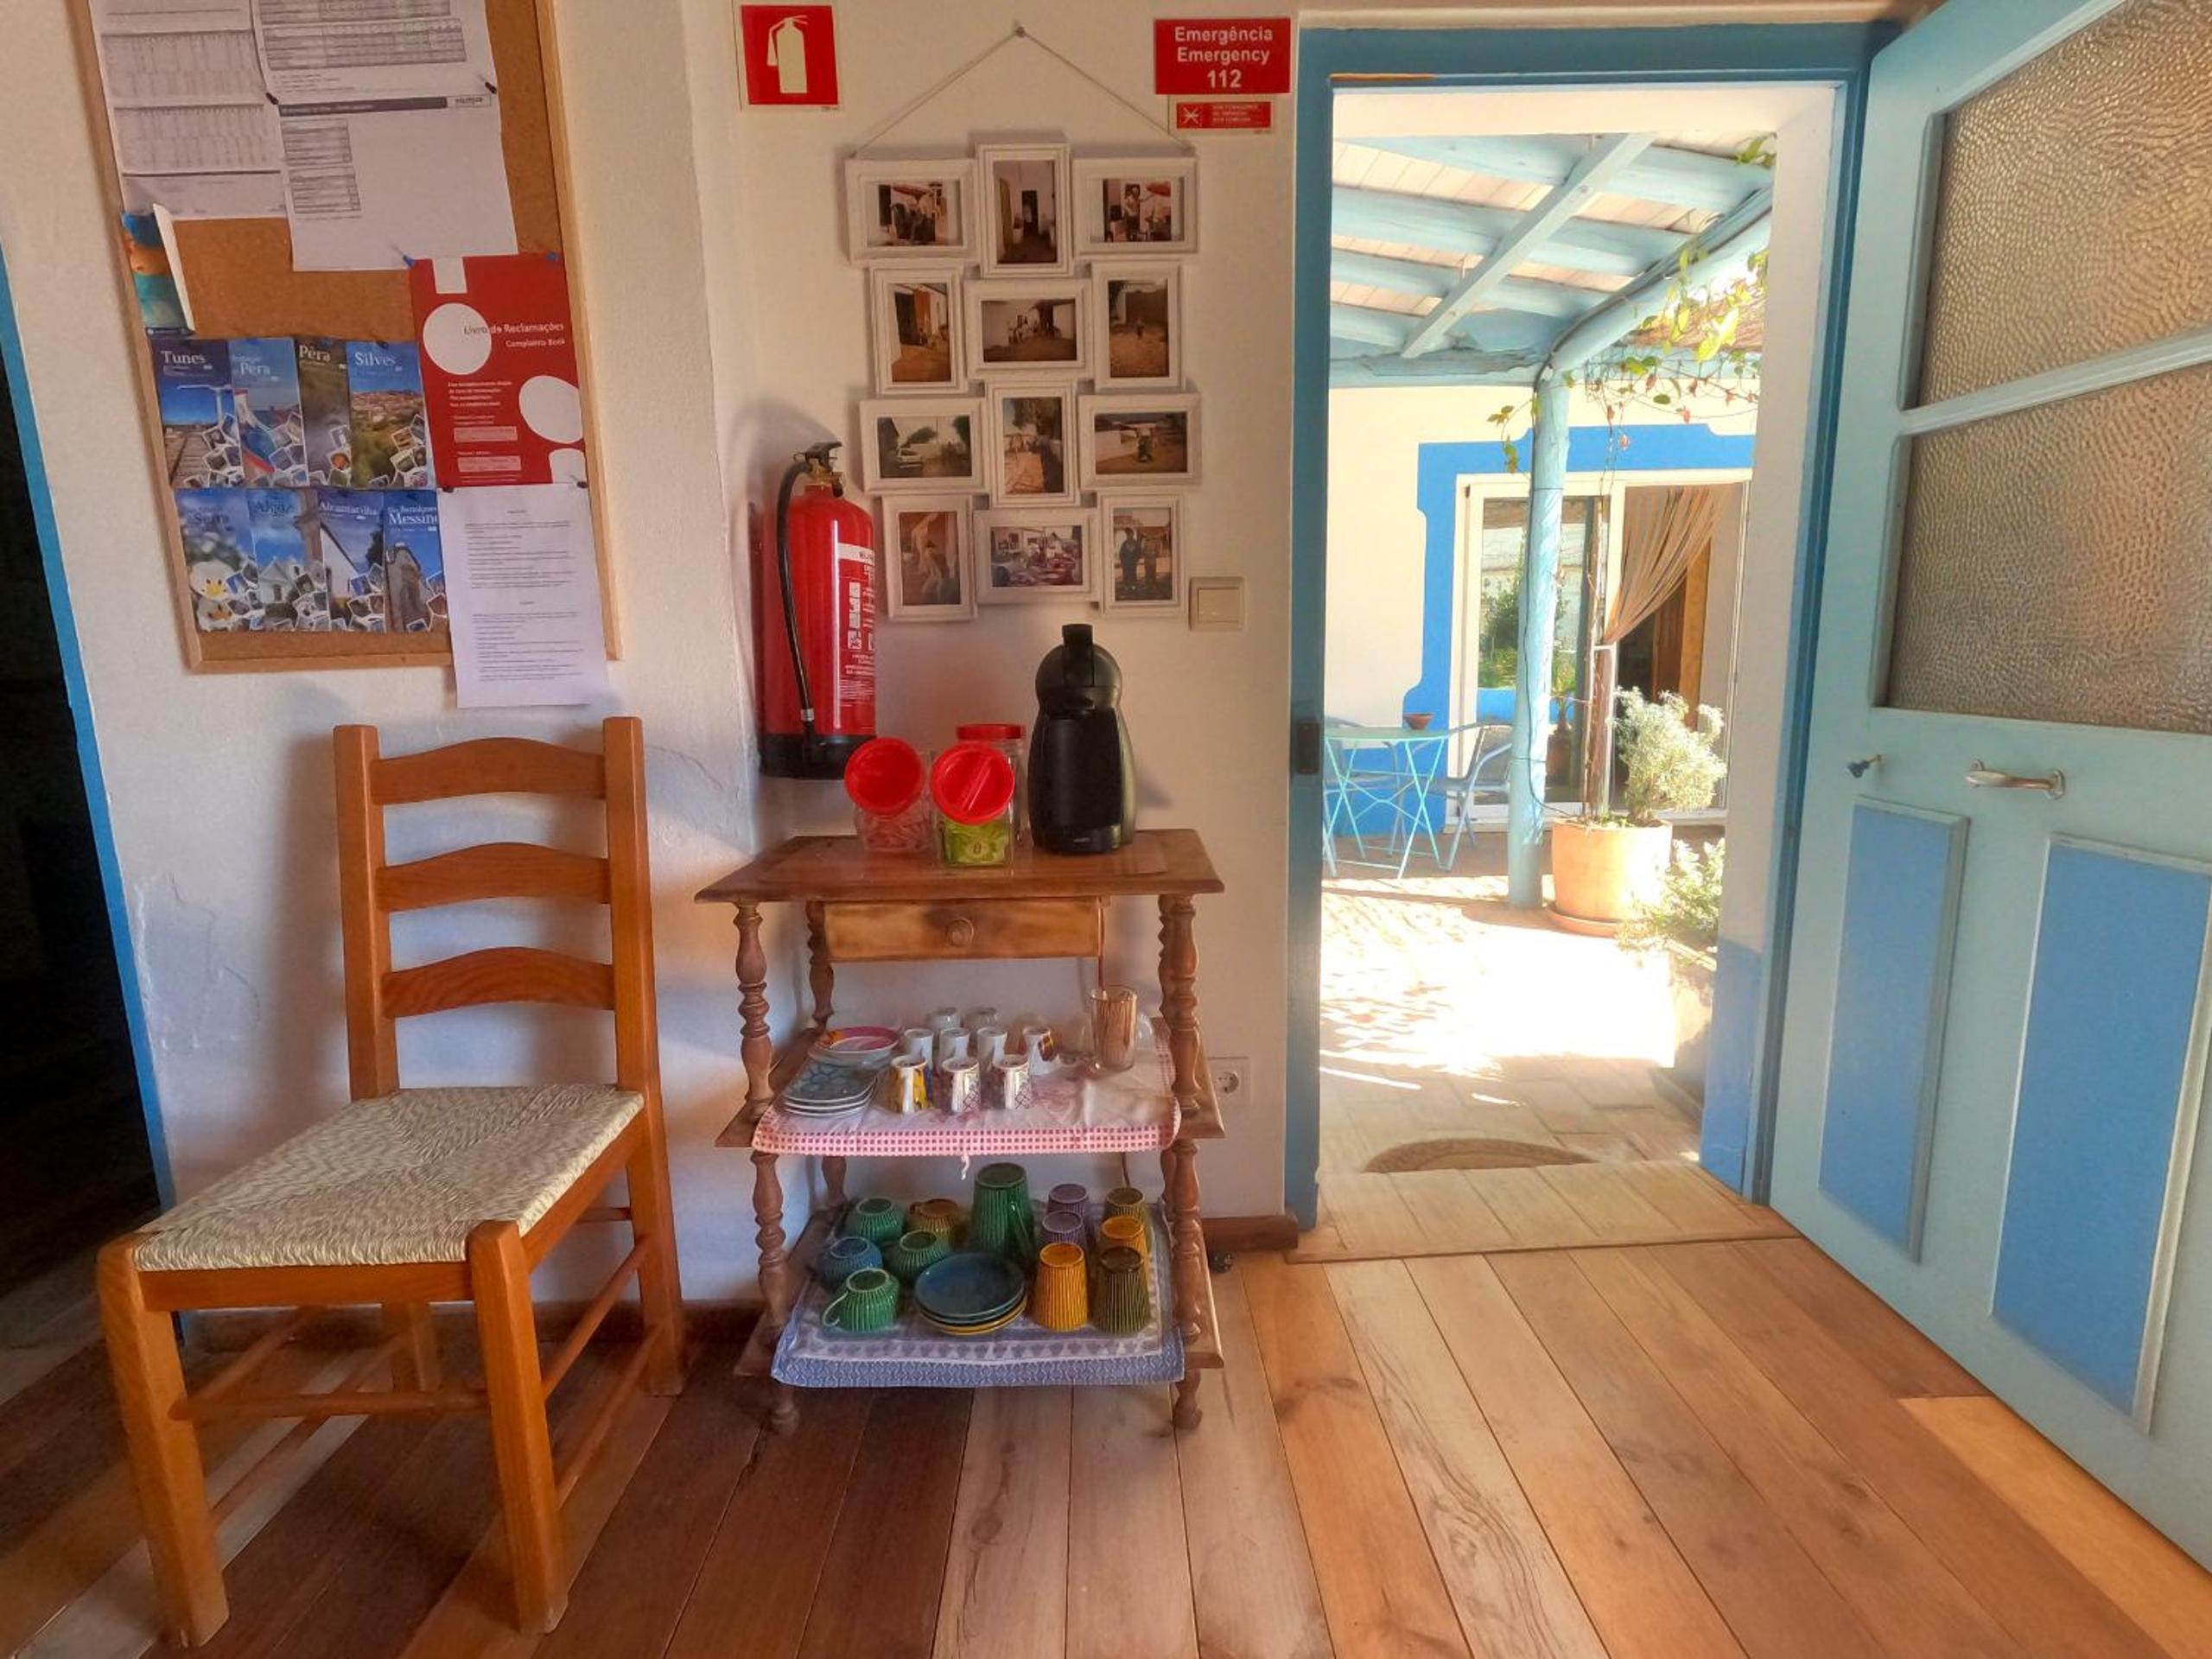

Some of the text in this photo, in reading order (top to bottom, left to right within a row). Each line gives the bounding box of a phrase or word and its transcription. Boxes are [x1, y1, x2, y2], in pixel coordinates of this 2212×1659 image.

[1174, 26, 1273, 45] Emergência
[1177, 47, 1270, 67] Emergency
[1207, 68, 1243, 89] 112
[504, 322, 564, 334] Reclamações
[548, 338, 566, 346] Book
[161, 350, 207, 364] Tunes
[354, 352, 396, 367] Silves
